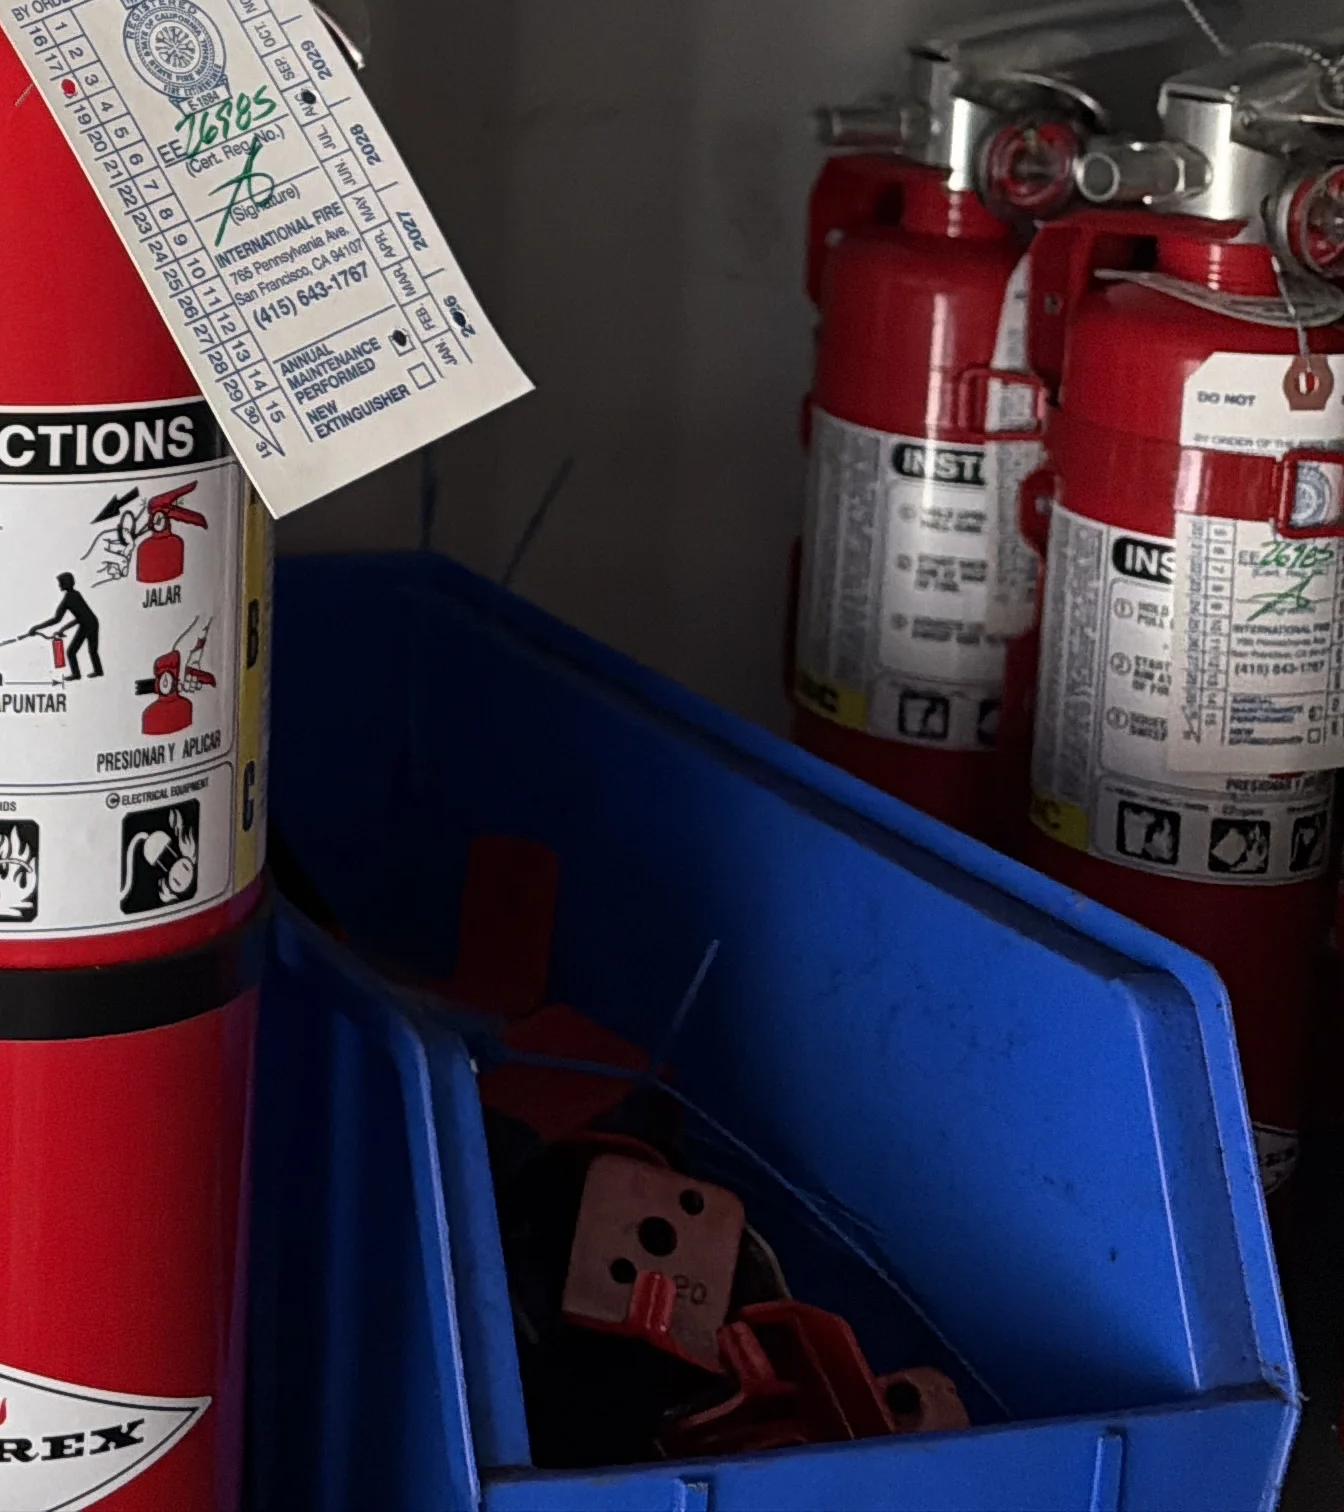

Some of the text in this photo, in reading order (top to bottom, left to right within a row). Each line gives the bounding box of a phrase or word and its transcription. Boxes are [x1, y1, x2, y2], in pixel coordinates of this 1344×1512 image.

[11, 3, 30, 22] BY
[156, 138, 189, 166] EE
[185, 123, 285, 178] (Cert. No.)
[214, 201, 344, 269] INTERNATIONAL FIRE
[228, 226, 350, 285] 765 Pennsylvania Ave.
[234, 237, 363, 306] San Francisco, CA 94107
[252, 260, 368, 331] (415) 643-1767
[280, 343, 335, 377] ANNUAL
[285, 336, 382, 390] MAINTENANCE
[293, 357, 376, 405] PERFORMED
[305, 399, 338, 425] NEW
[313, 383, 411, 439] EXTINGUISHER
[142, 584, 182, 608] JALAR
[96, 729, 221, 772] PRESIONAR Y APLICAR
[122, 787, 168, 806] ELECTRICAL
